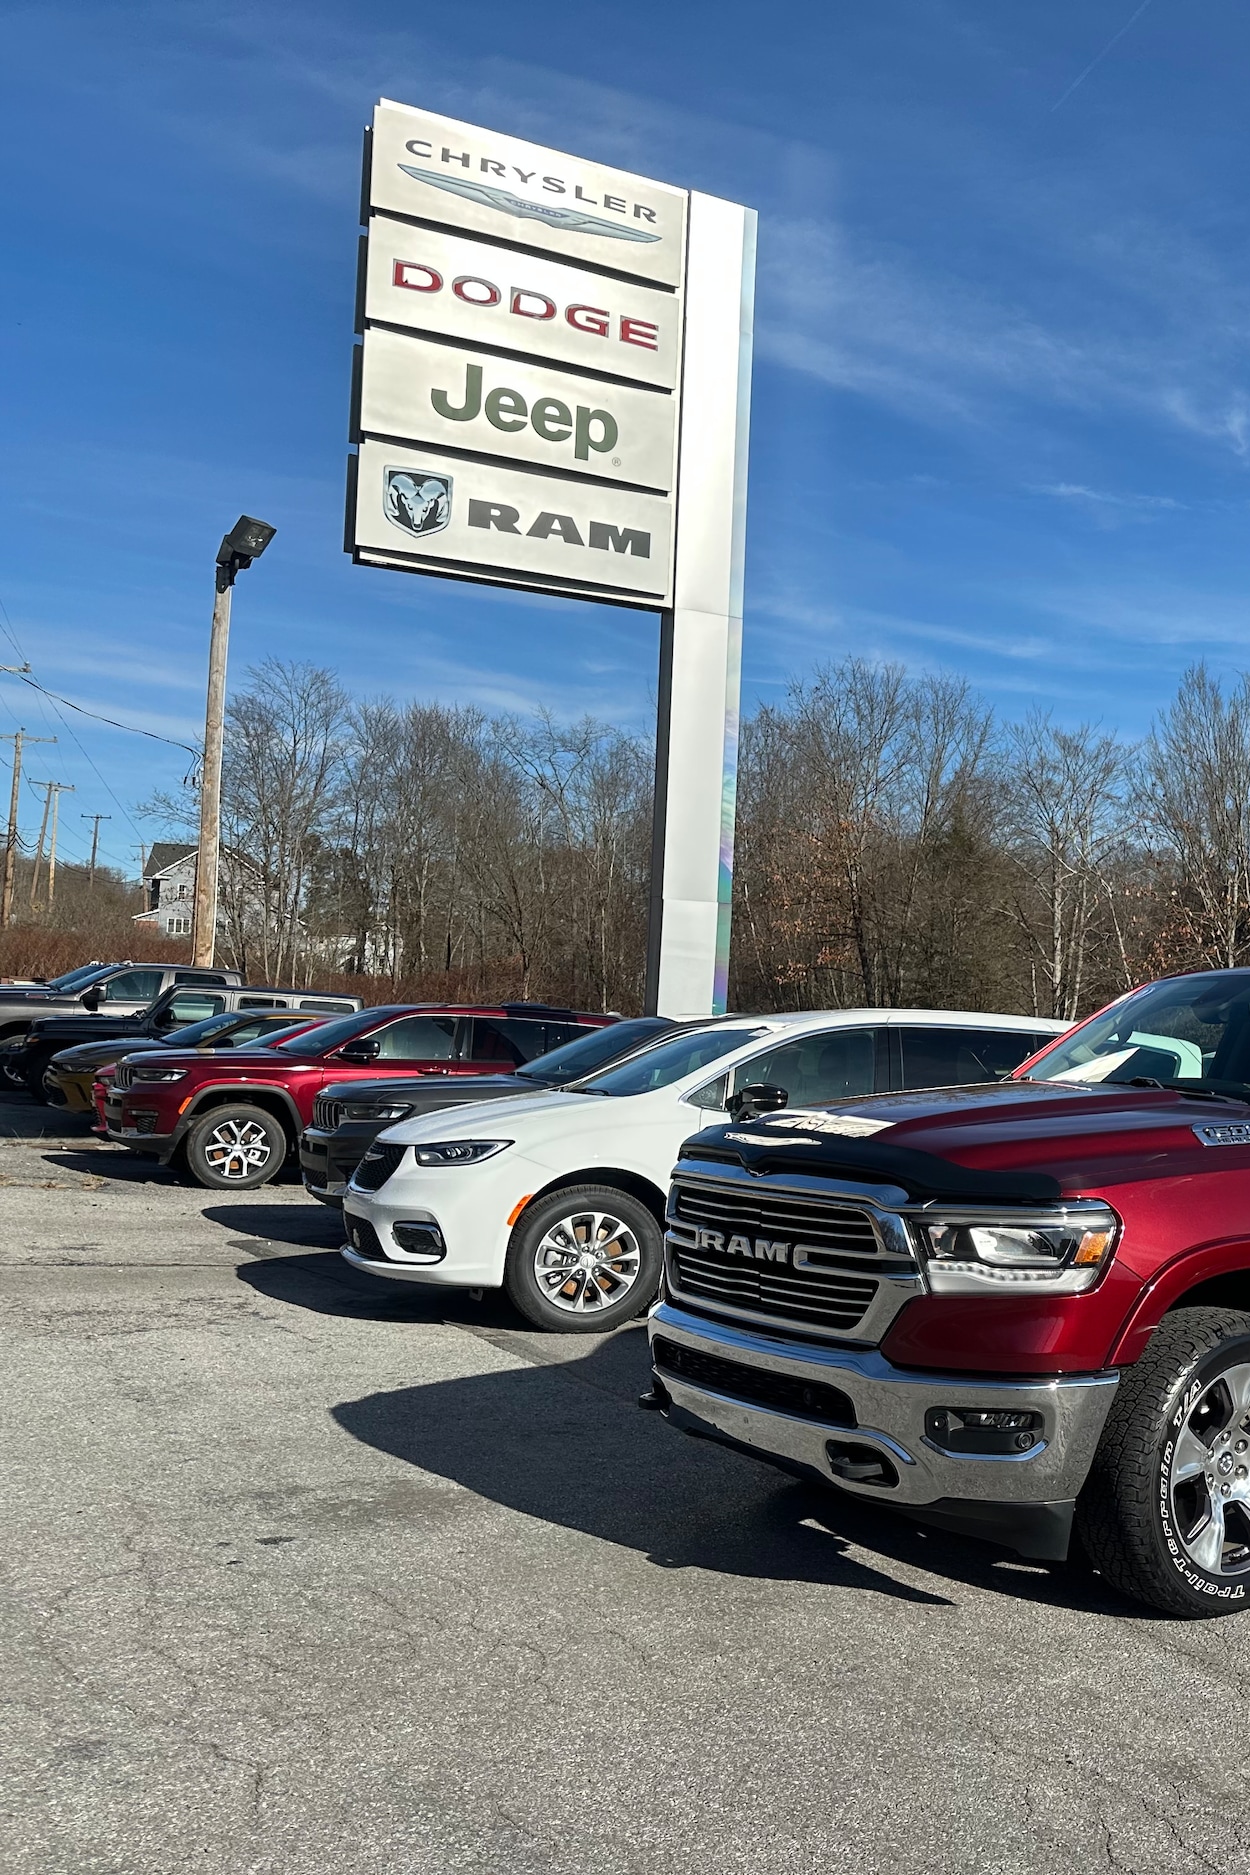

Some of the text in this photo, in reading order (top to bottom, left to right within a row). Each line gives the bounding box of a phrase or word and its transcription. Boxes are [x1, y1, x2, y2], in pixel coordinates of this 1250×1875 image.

[404, 139, 658, 224] CHRYSLER
[510, 200, 562, 218] CHRYSLER
[392, 258, 660, 351] DODGE
[431, 363, 619, 461] Jeep
[468, 498, 651, 559] RAM
[701, 1228, 789, 1264] RAM
[1160, 1440, 1246, 1599] Trail-Terrain
